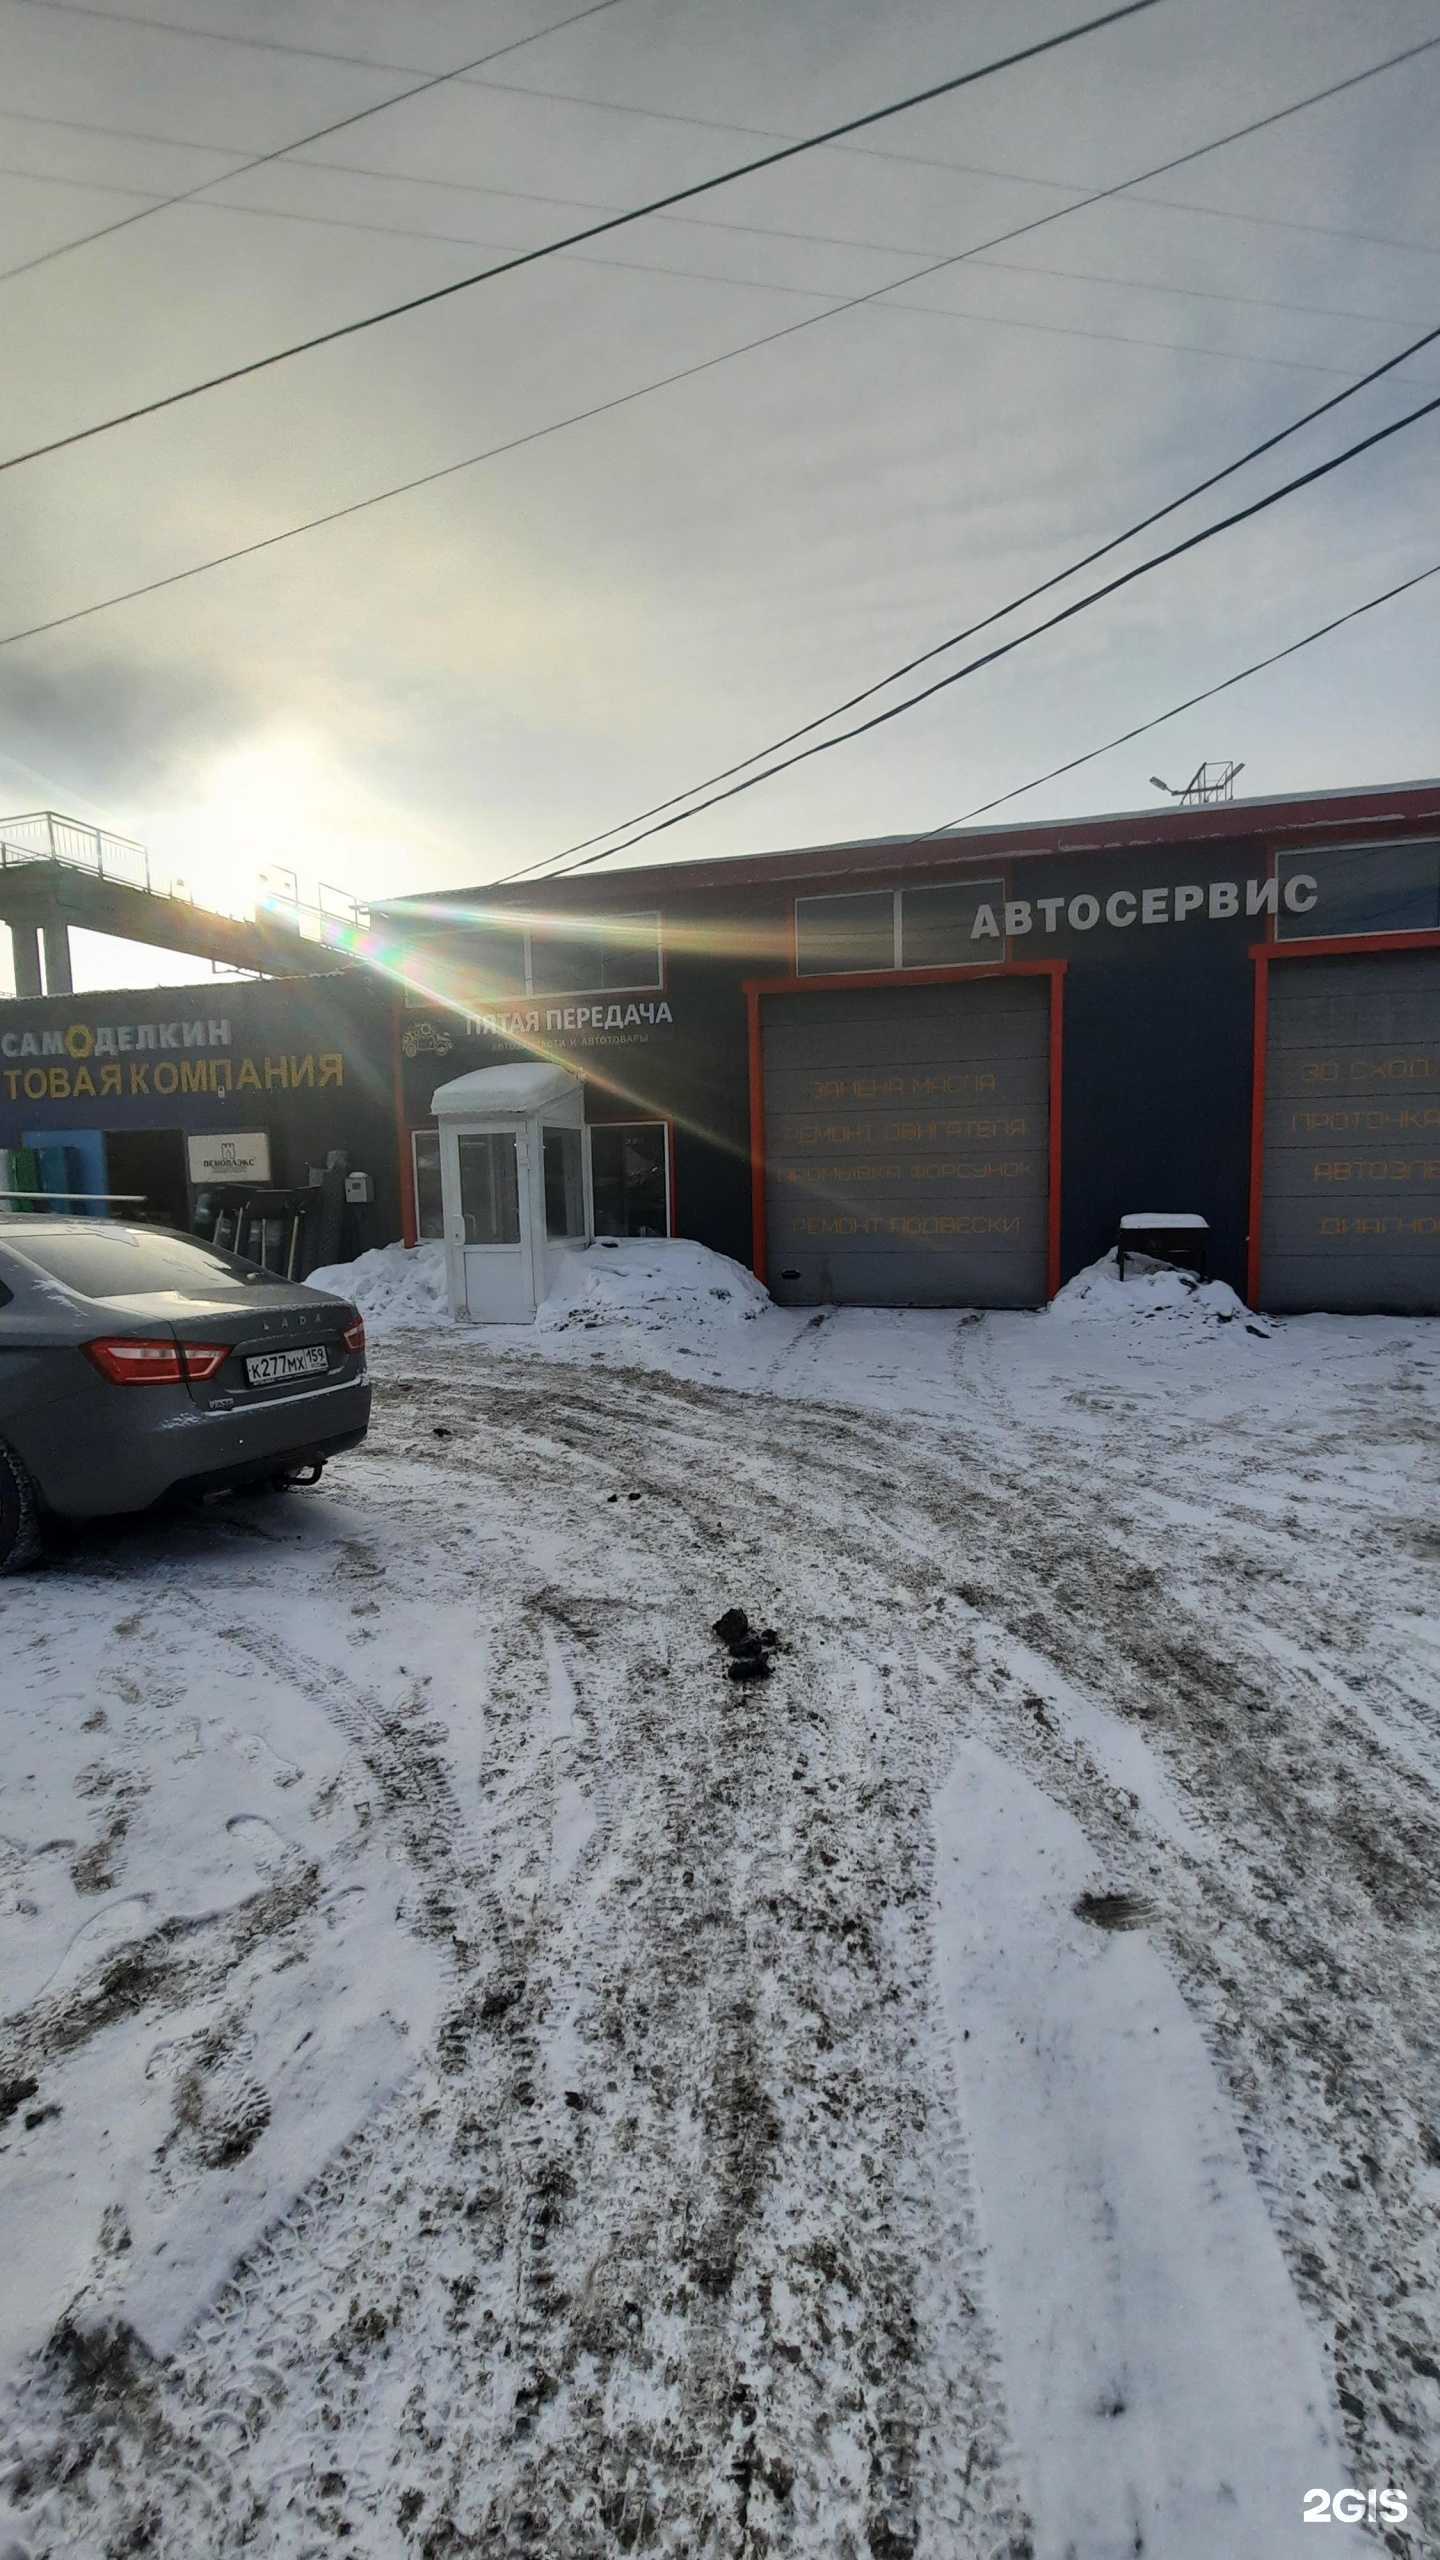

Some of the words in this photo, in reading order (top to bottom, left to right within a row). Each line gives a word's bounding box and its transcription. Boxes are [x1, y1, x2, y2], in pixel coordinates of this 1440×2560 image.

[970, 874, 1319, 939] АВТОСЕРВИС
[466, 1010, 539, 1035] ПЯТАЯ
[546, 1002, 673, 1032] ПЕРЕДАЧА
[1, 1019, 232, 1058] САМОДЕЛКИН
[4, 1063, 123, 1100] ТОВАЯ
[130, 1053, 345, 1097] КОМПАНИЯ
[815, 1077, 904, 1097] ЗАМЕНА
[886, 1118, 1026, 1140] ДВИГАТЕЛЯ
[911, 1160, 1034, 1178] ФОРСУНОК
[793, 1216, 880, 1235] РЕМОНТ
[888, 1216, 1023, 1235] ПОДВЕСКИ
[263, 1313, 322, 1331] LADA
